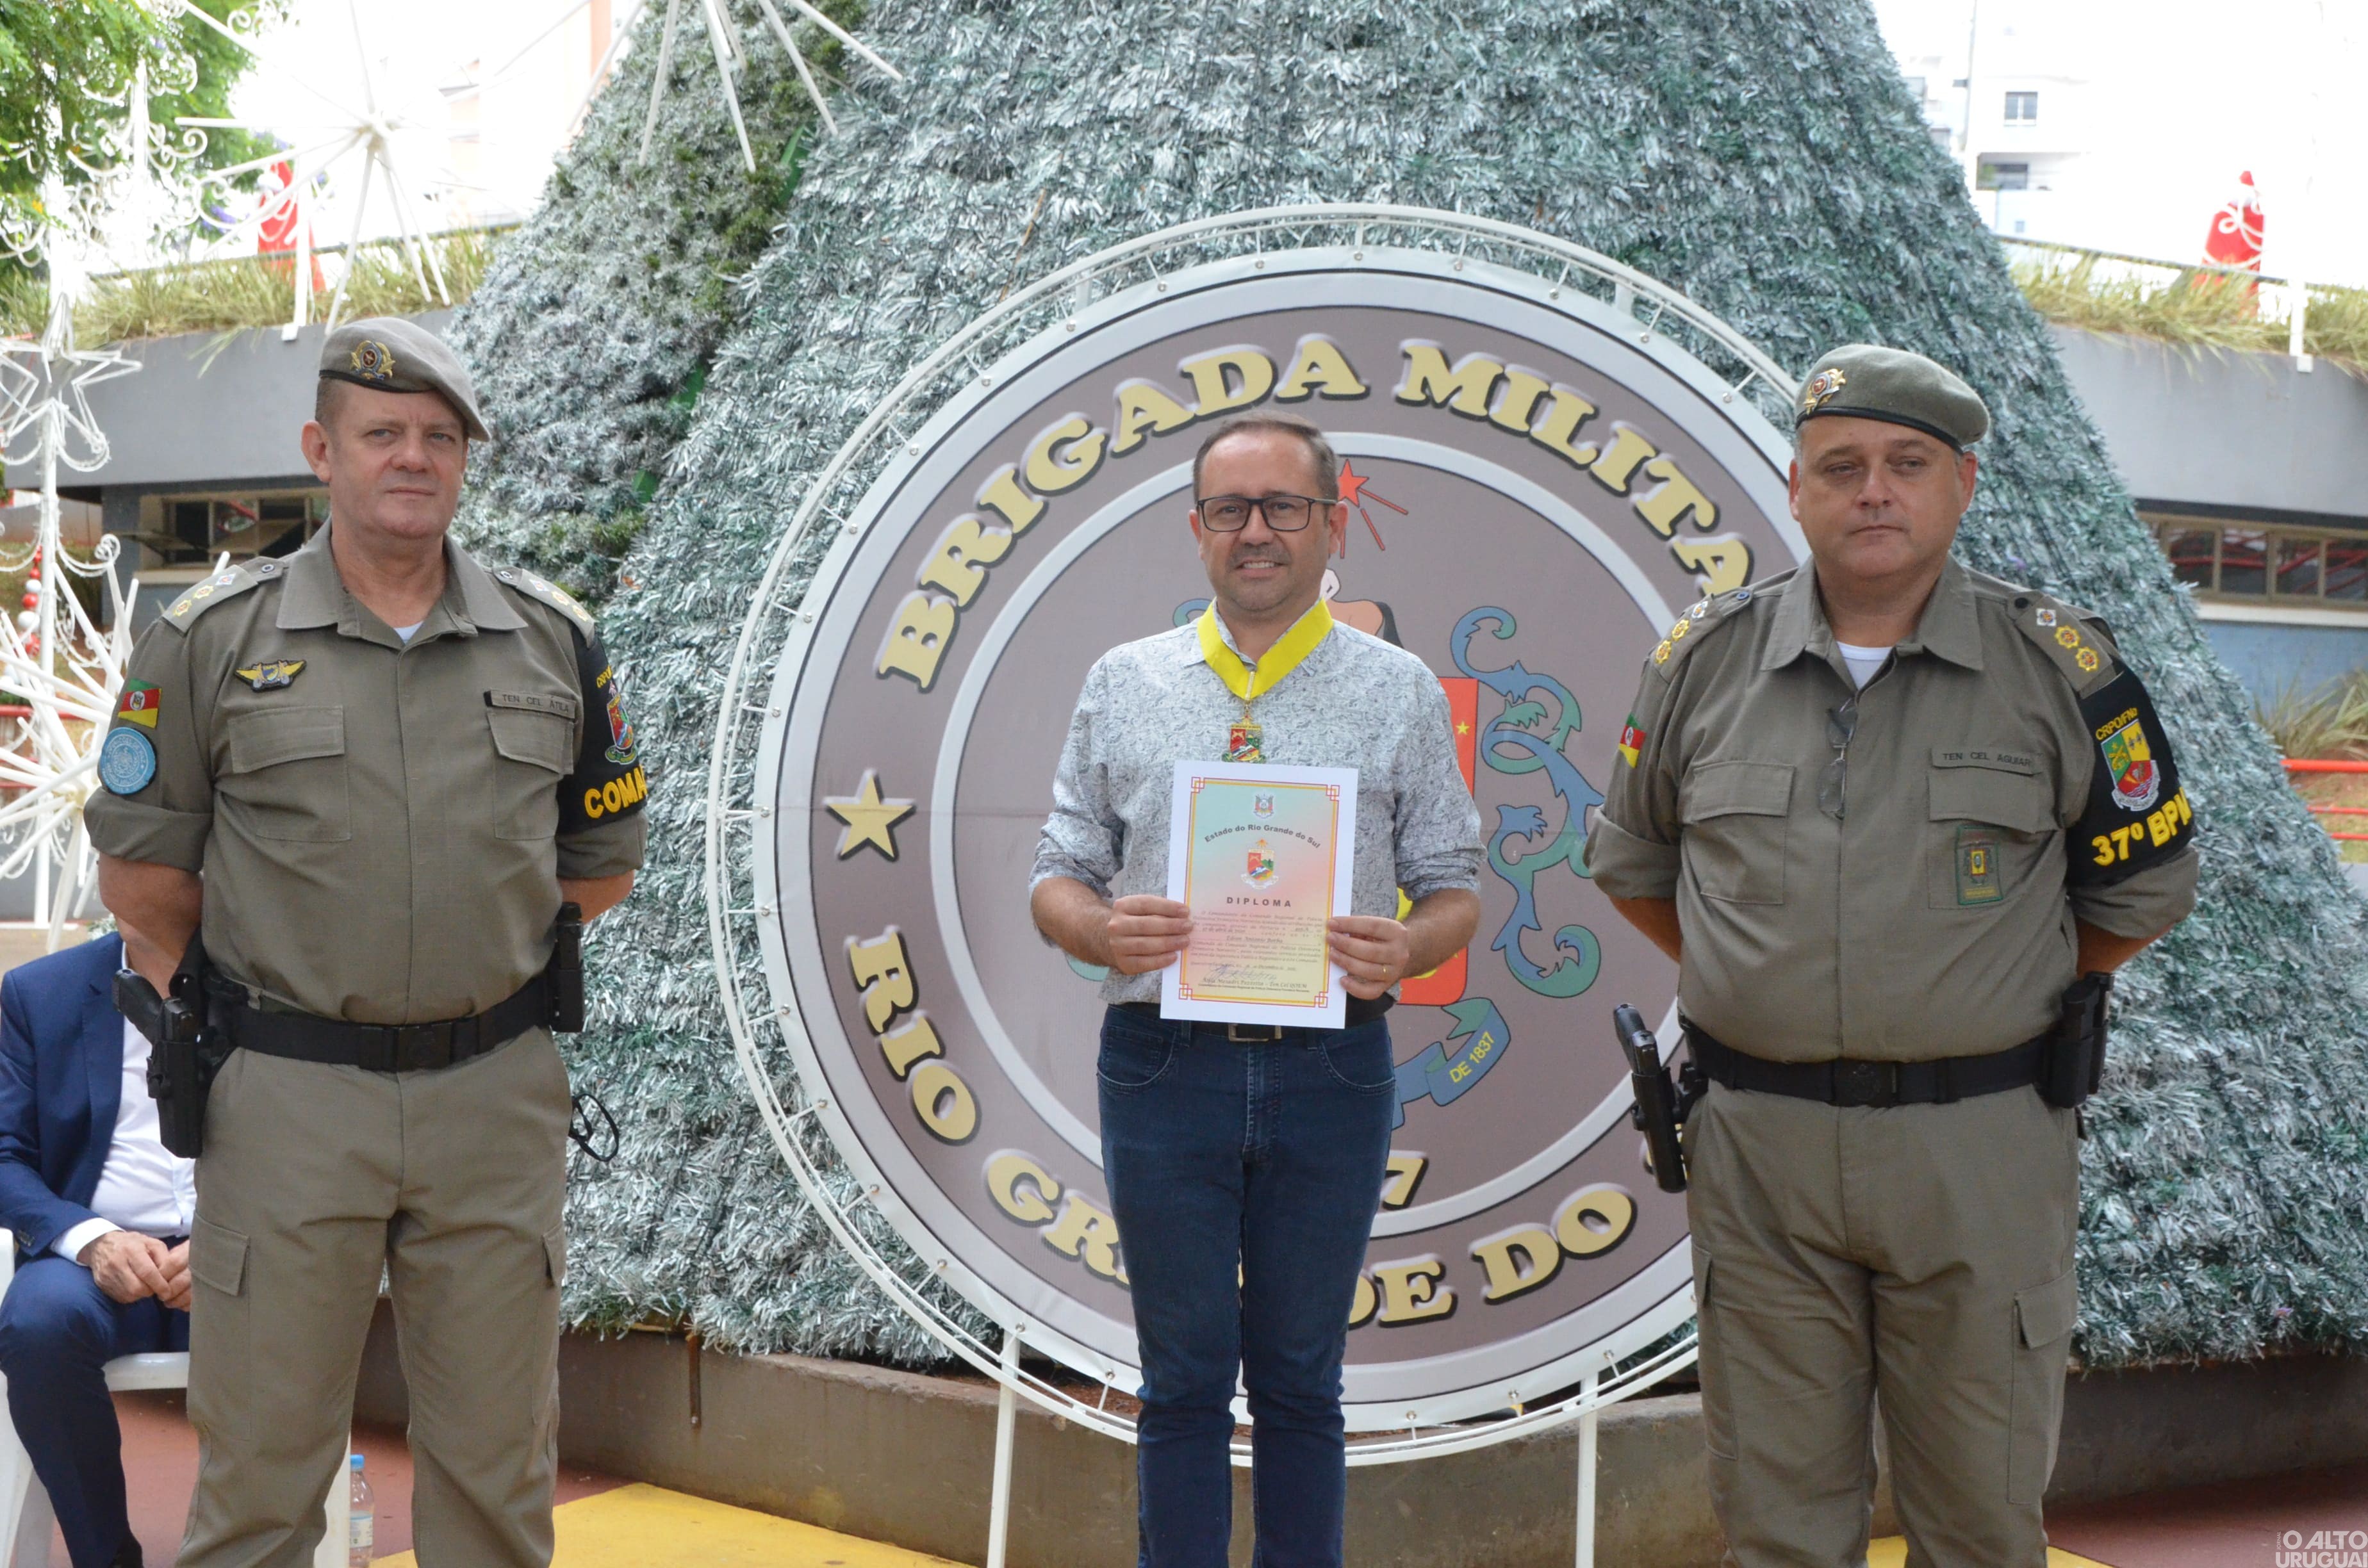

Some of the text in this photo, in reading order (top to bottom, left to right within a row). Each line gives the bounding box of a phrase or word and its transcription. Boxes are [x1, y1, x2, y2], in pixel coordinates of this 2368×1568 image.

[876, 333, 1753, 693] BRIGADA MILITA
[502, 694, 520, 703] TEN
[527, 696, 541, 706] CEL
[1943, 753, 1963, 761] TEN
[1970, 751, 1990, 760] CEL
[1205, 827, 1233, 843] Estado
[1263, 824, 1294, 836] Grande
[1295, 831, 1306, 840] do
[1307, 837, 1321, 849] Sul
[1226, 896, 1292, 908] DIPLOMA
[1449, 1031, 1495, 1083] DE 1837
[844, 924, 982, 1146] RIO
[1468, 1182, 1638, 1305] DO
